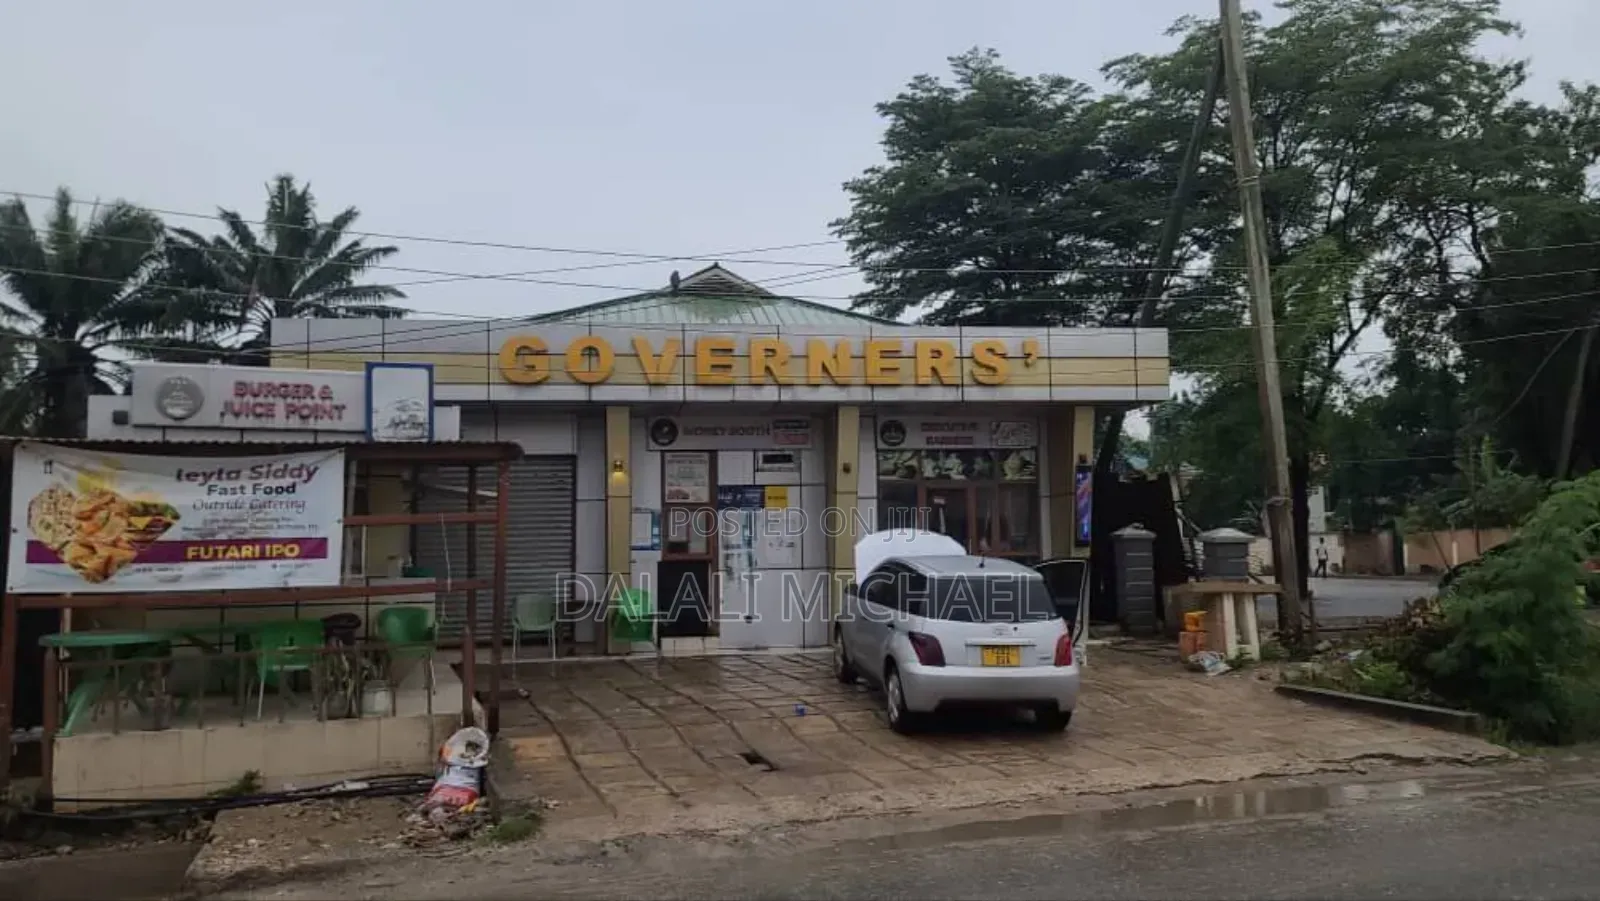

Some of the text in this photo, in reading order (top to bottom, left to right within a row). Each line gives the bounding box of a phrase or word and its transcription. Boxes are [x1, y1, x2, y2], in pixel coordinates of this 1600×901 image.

[499, 336, 1041, 386] GOVERNERS'
[233, 381, 333, 400] BURGER &
[220, 400, 346, 420] JUICE POINT
[248, 462, 319, 483] Siddy
[207, 482, 296, 496] Fast Food
[187, 543, 300, 559] FUTARI IPO
